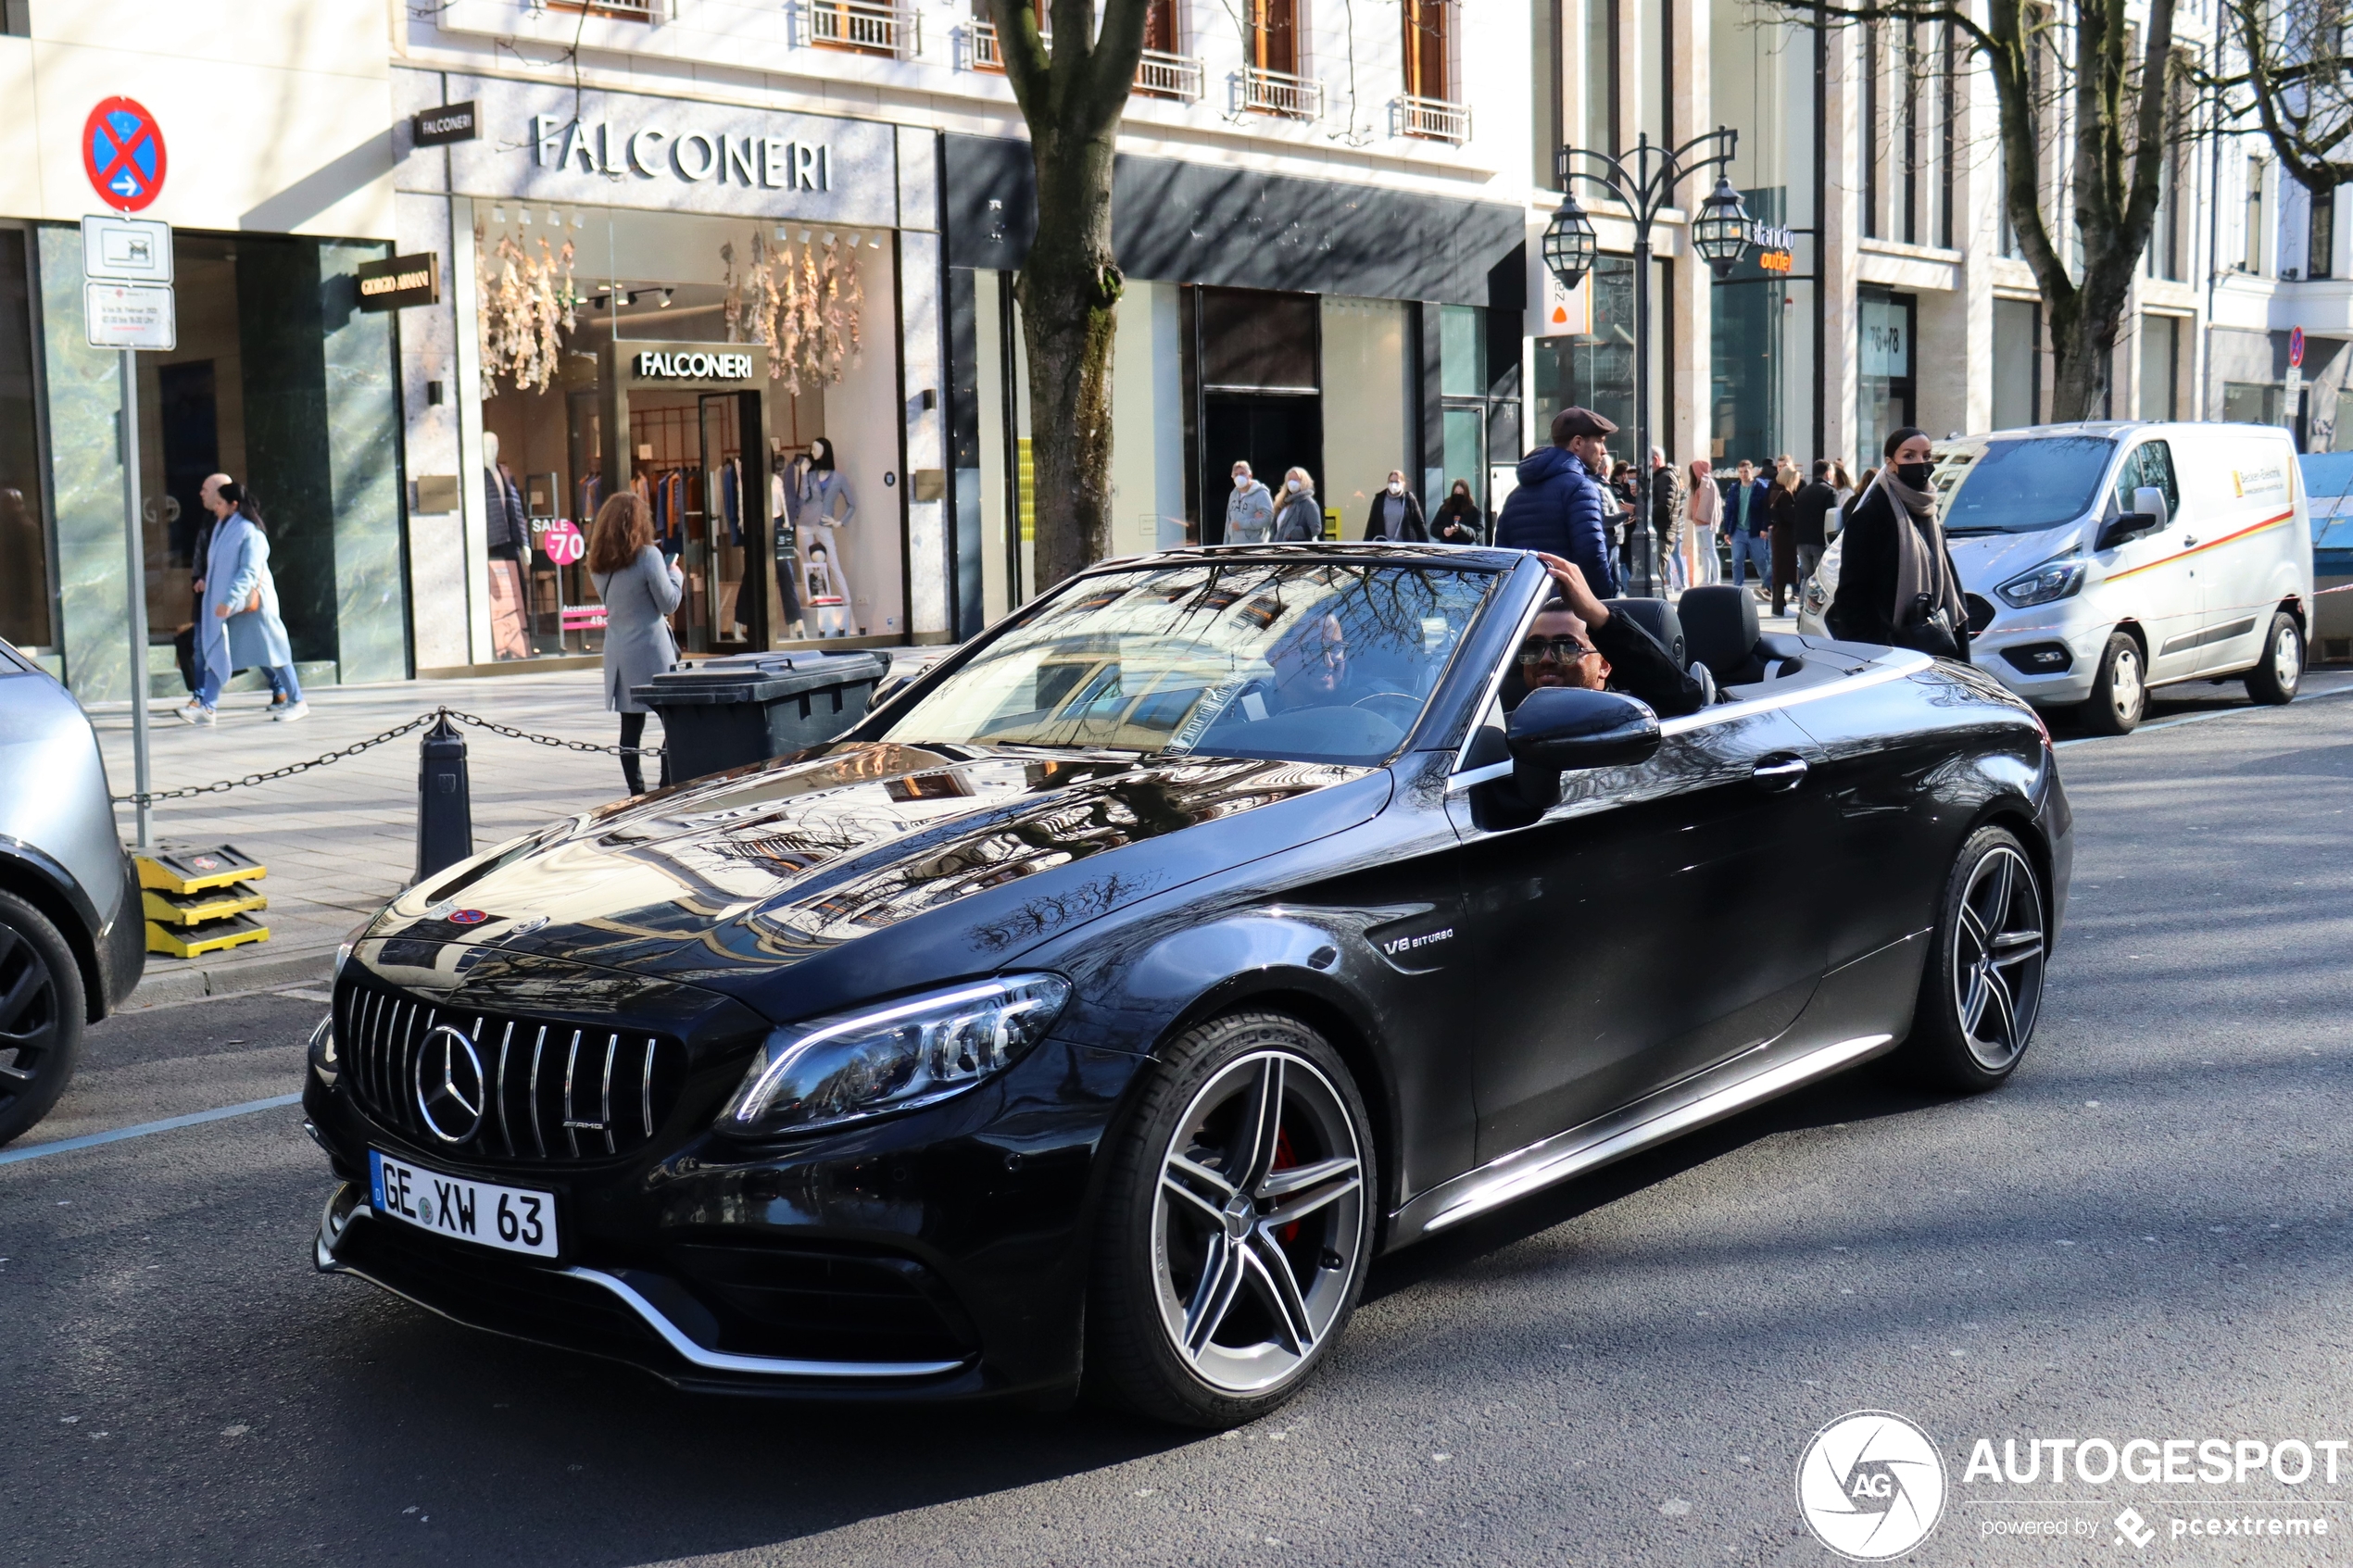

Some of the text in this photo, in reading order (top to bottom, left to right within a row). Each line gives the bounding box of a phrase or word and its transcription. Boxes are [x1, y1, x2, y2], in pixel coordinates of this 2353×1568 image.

[422, 114, 472, 135] FALCONERI
[536, 113, 832, 191] FALCONERI
[1760, 250, 1793, 271] outlet
[361, 275, 396, 295] GIORGIO
[640, 351, 752, 378] FALCONERI
[1503, 404, 1515, 419] 74
[532, 519, 569, 533] SALE
[549, 533, 585, 560] -70
[1383, 928, 1453, 956] V8 BITURBO
[574, 1122, 604, 1130] AMG
[375, 1187, 381, 1201] D
[383, 1162, 543, 1247] GE XW 63
